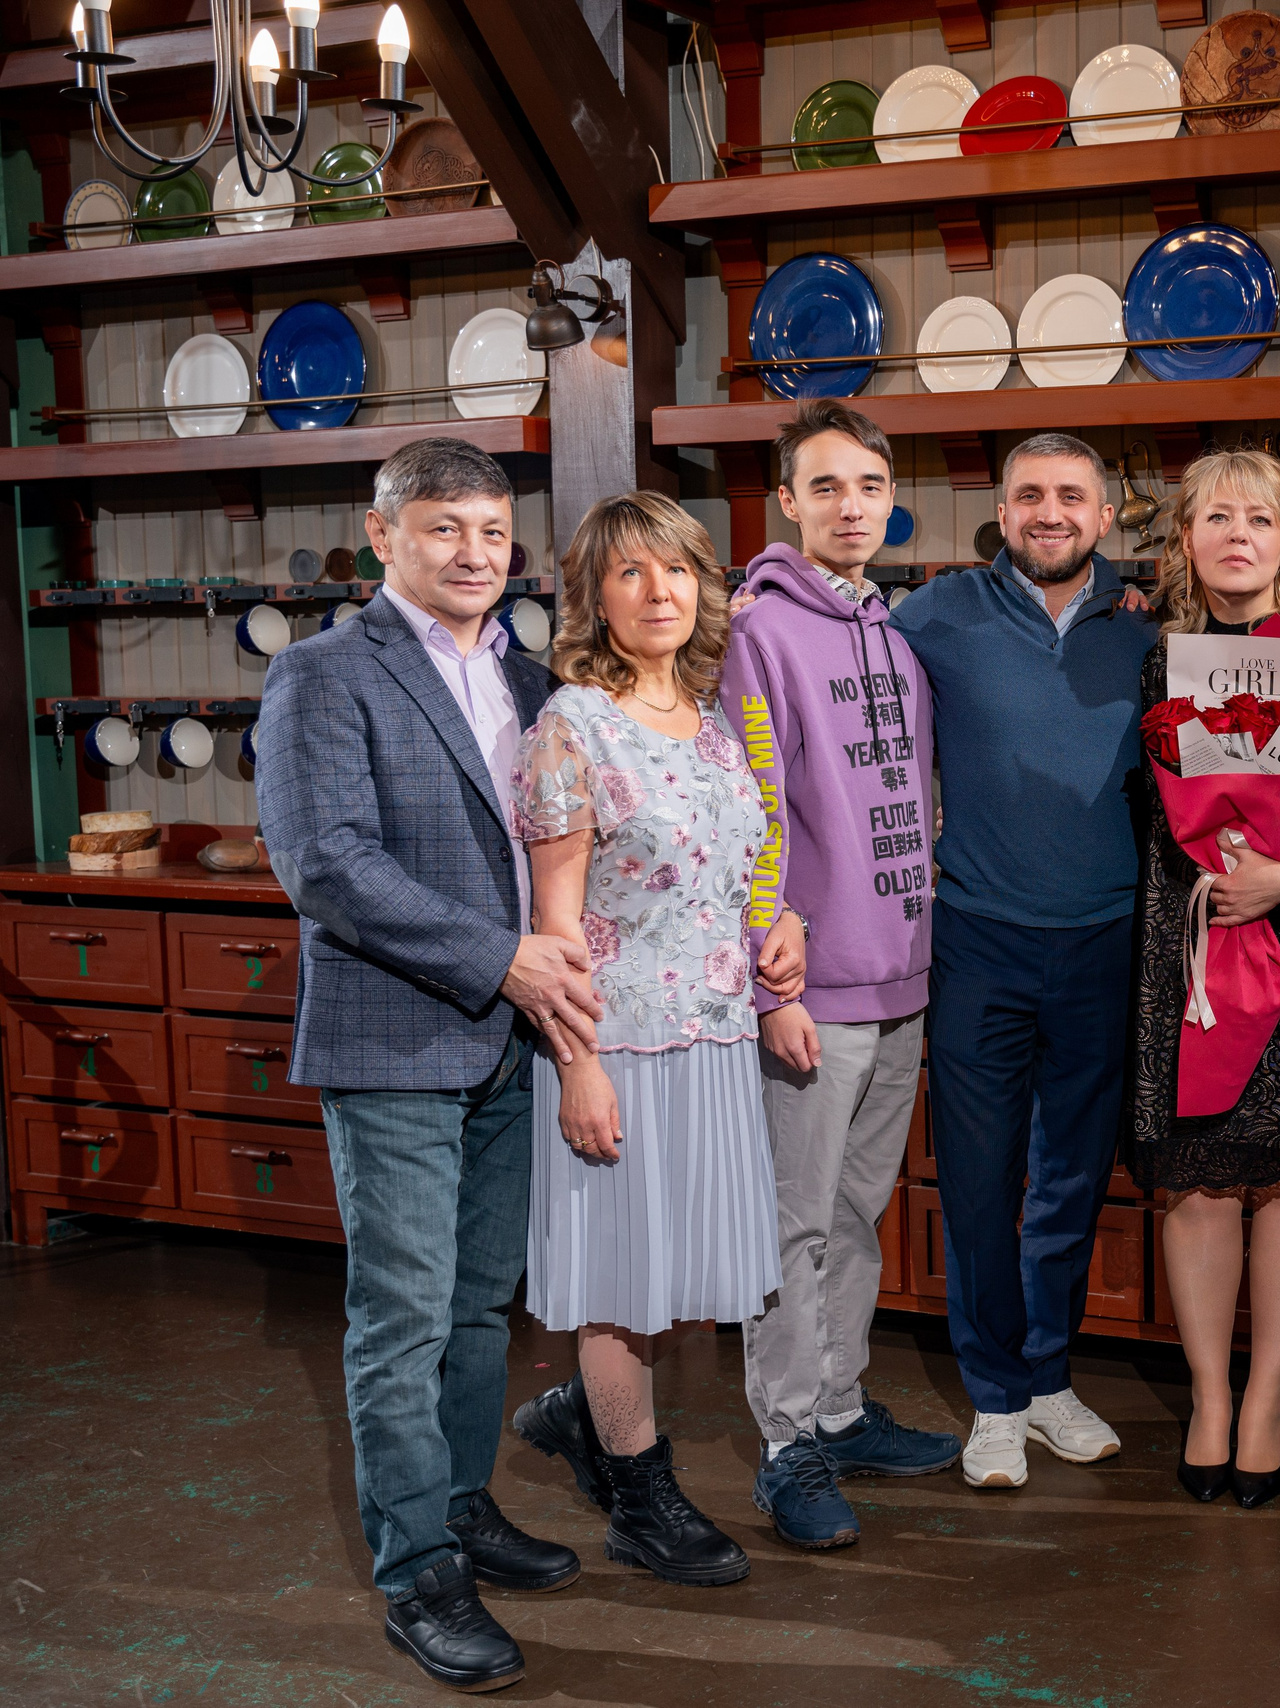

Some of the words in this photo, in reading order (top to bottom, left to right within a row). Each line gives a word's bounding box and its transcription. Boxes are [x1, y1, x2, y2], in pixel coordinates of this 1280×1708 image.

[1241, 658, 1275, 670] LOVE
[829, 677, 858, 704] NO
[742, 694, 774, 770] MINE
[843, 739, 892, 768] YEAR
[760, 778, 779, 814] OF
[869, 800, 919, 832] FUTURE
[749, 821, 783, 928] RITUALS
[874, 868, 912, 897] OLD
[77, 945, 90, 976] 1
[246, 957, 264, 989] 2
[80, 1047, 97, 1076] 4
[252, 1061, 268, 1093] 5
[87, 1144, 100, 1173] 7
[255, 1163, 274, 1194] 8
